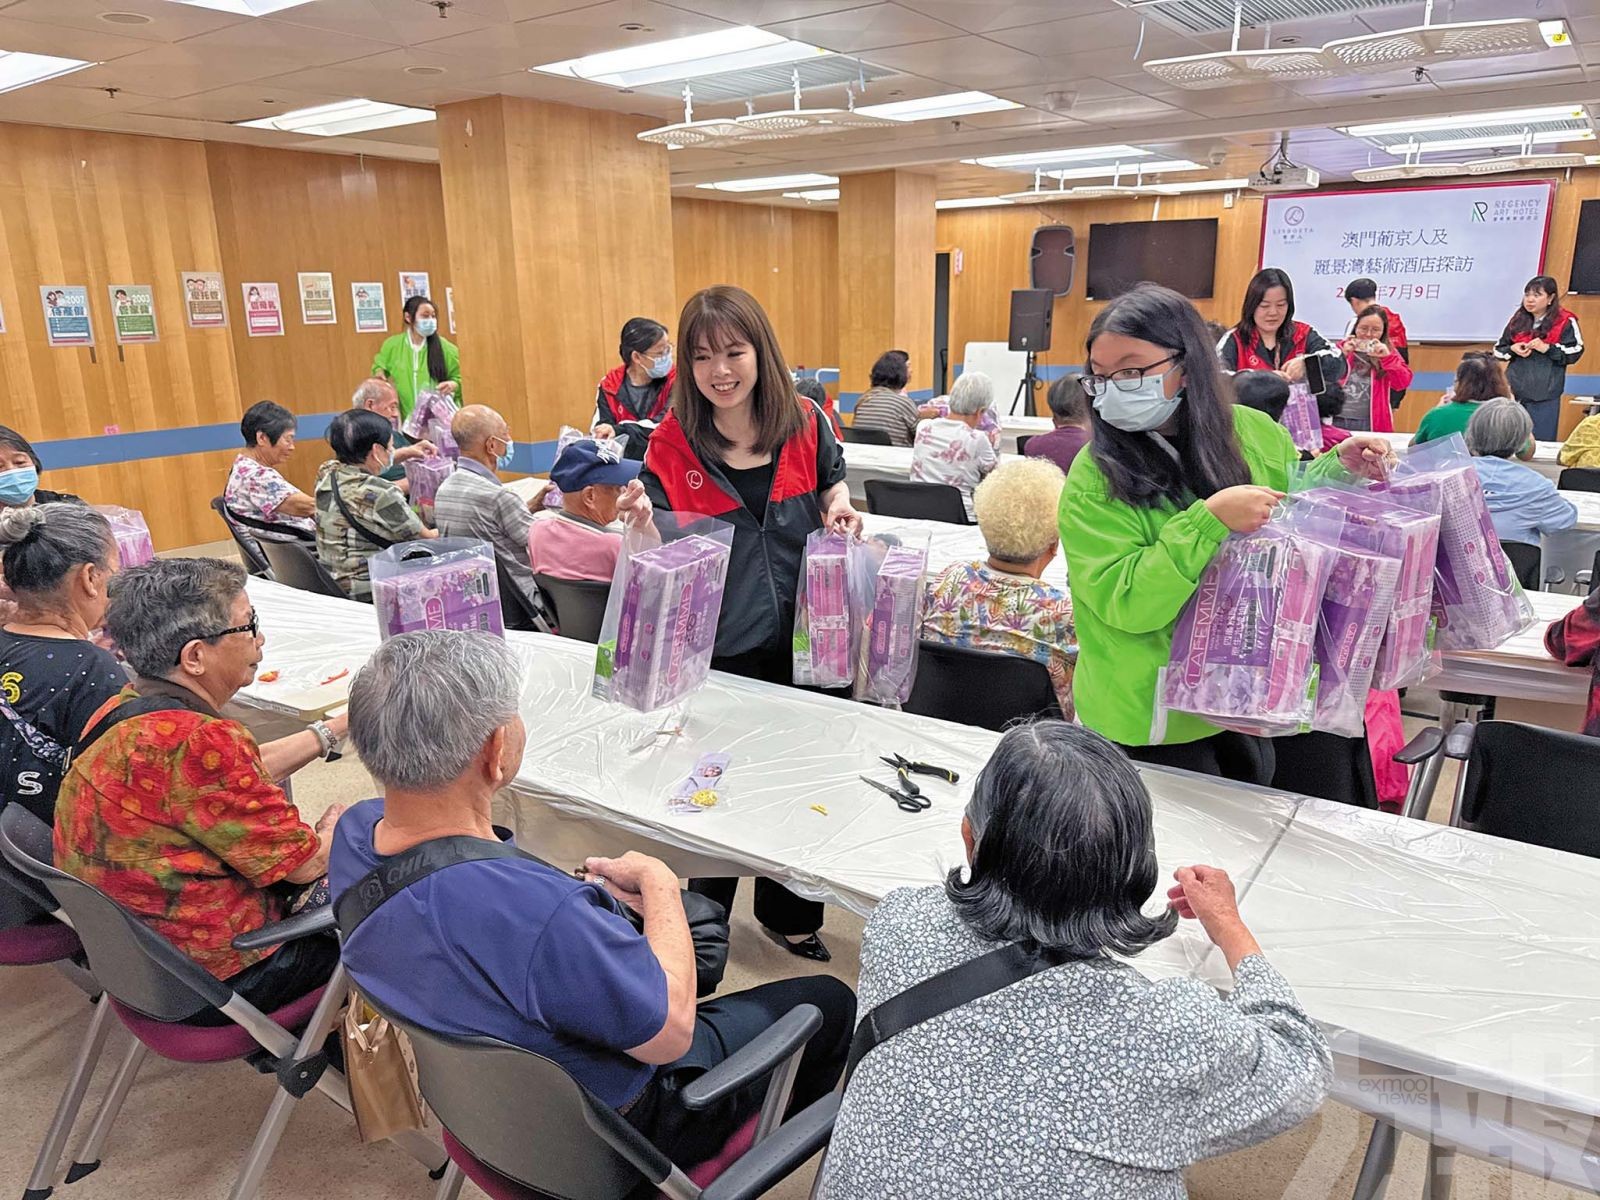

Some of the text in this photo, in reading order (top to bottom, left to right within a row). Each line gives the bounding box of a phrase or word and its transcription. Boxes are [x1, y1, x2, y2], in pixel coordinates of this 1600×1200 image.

[1494, 199, 1541, 208] REGENCY
[1494, 207, 1539, 216] ART HOTEL
[1341, 228, 1448, 248] 澳門葡京人及
[1313, 255, 1474, 275] 麗景灣藝術酒店探訪
[1188, 574, 1218, 678] LAFEMME
[17, 771, 43, 795] S
